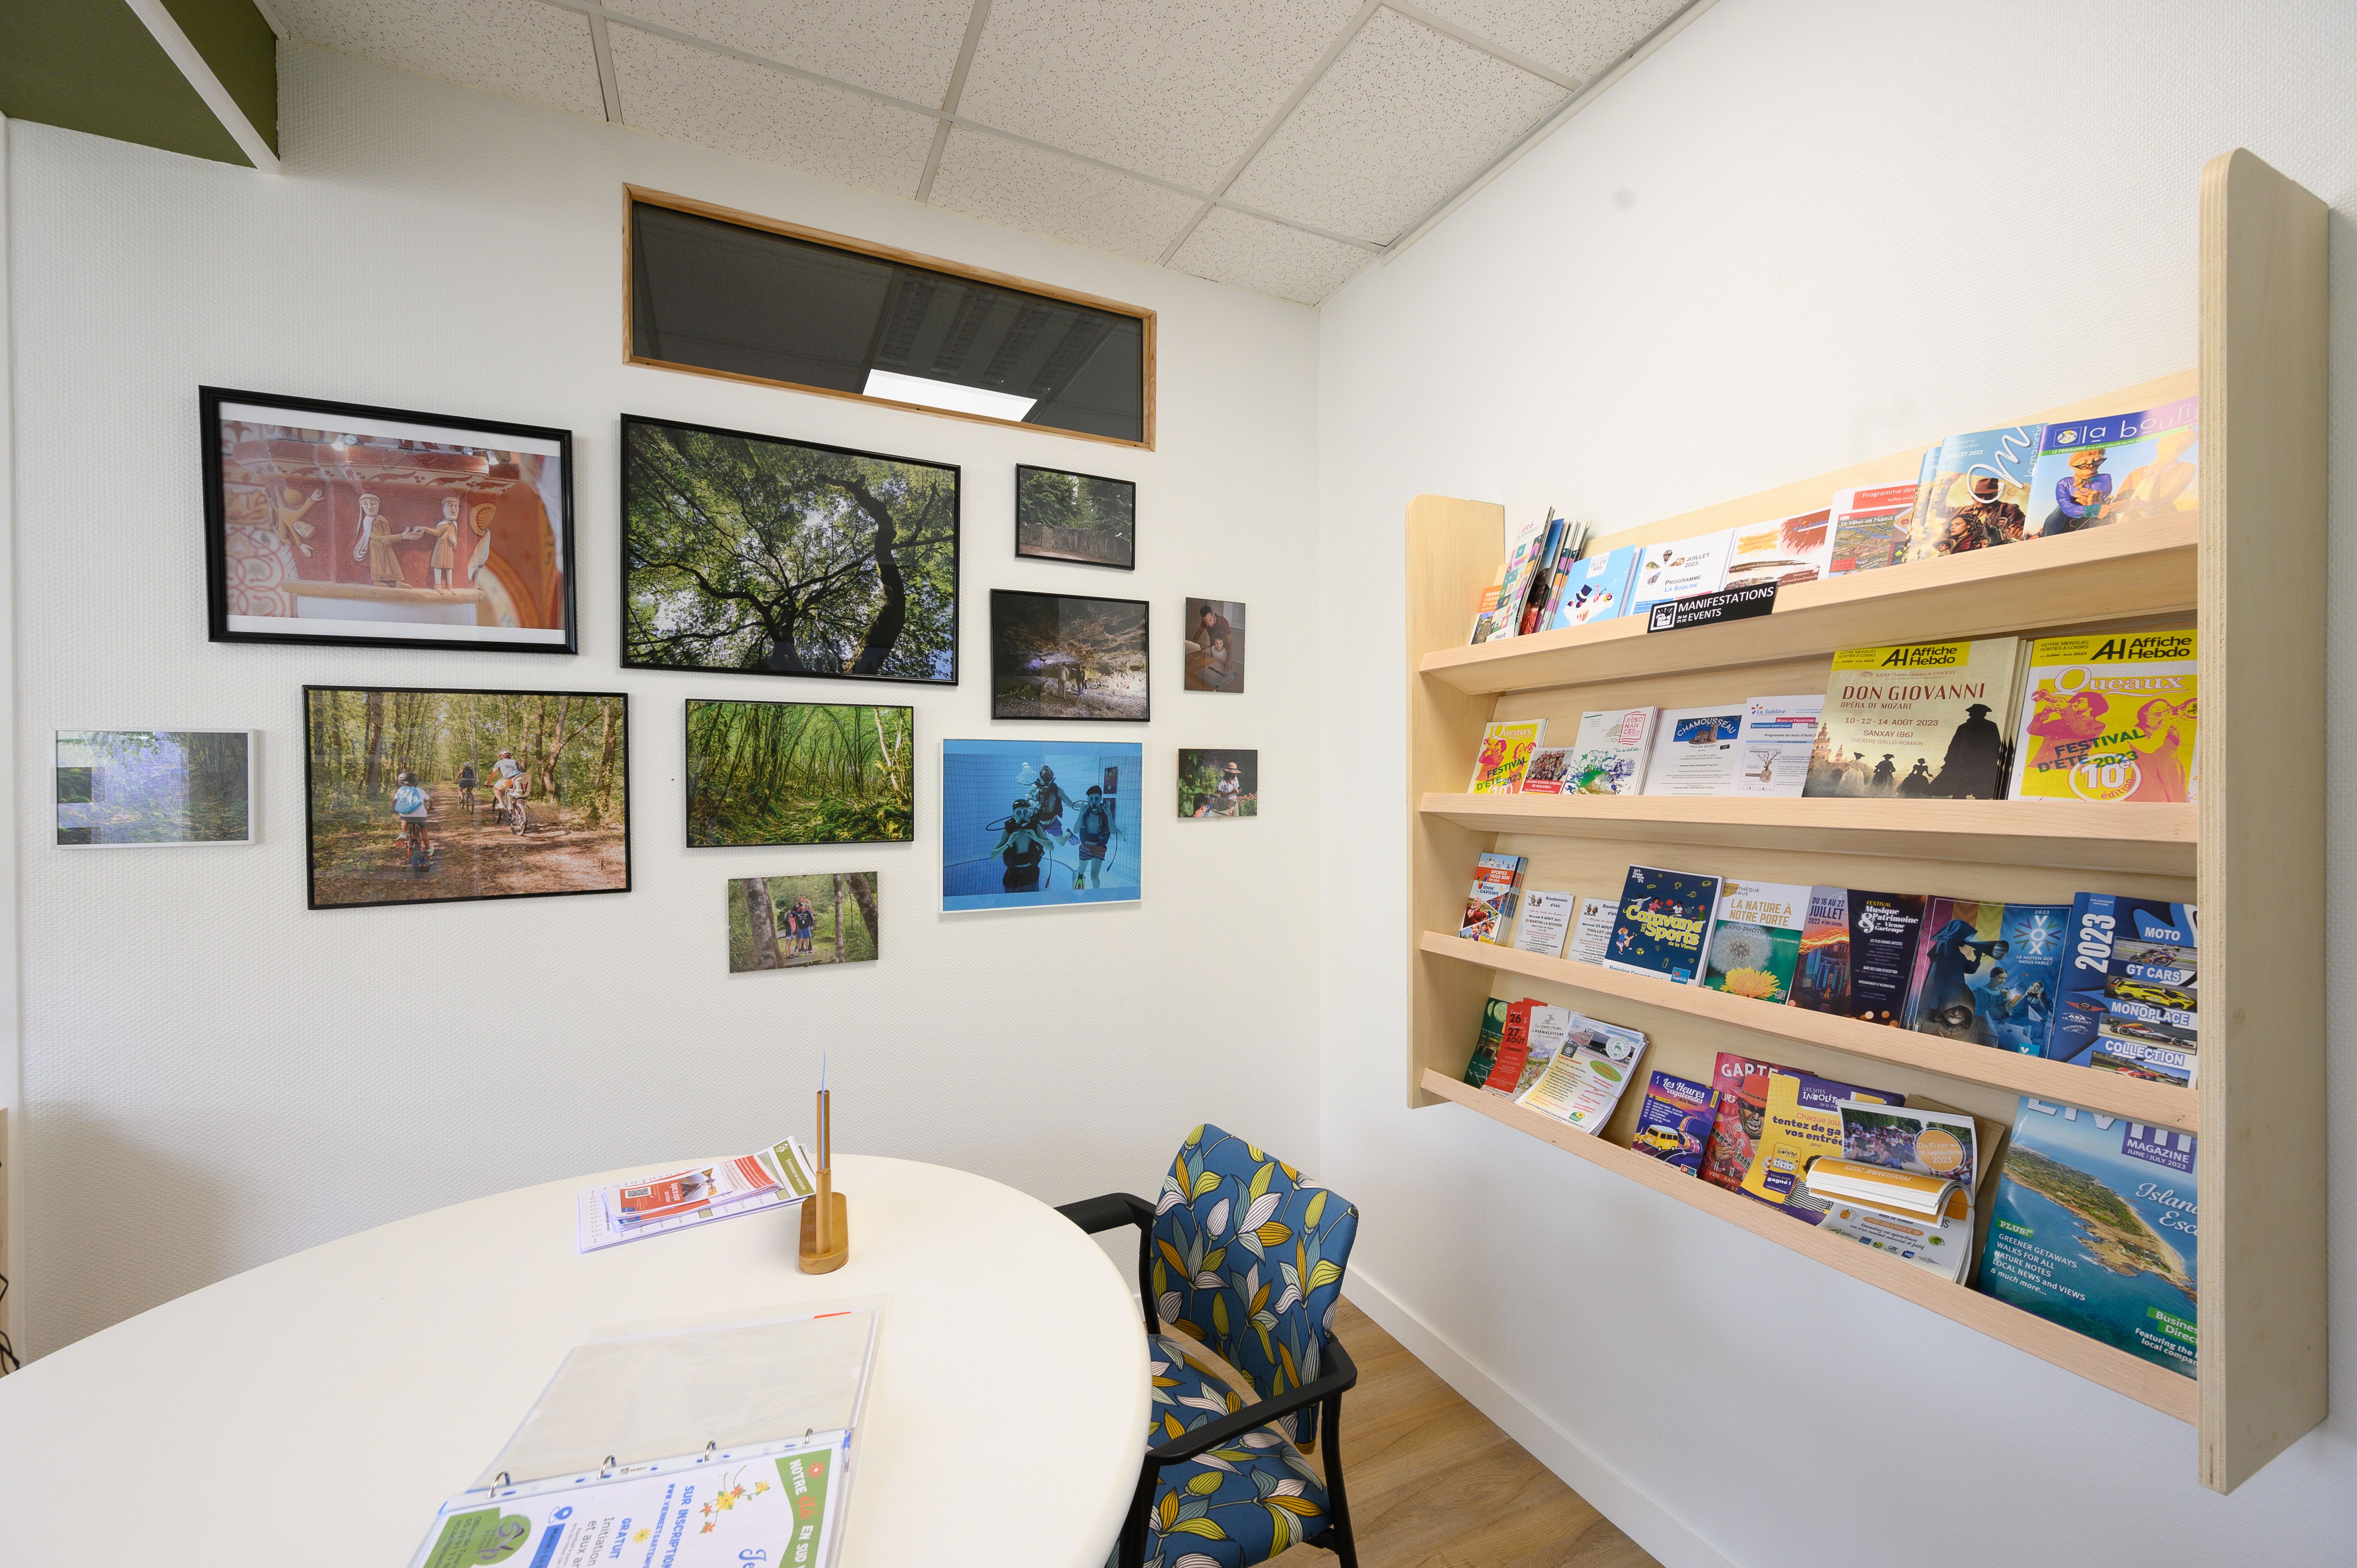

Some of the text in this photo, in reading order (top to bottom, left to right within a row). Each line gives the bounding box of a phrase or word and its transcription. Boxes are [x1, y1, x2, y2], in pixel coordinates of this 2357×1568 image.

[2082, 426, 2106, 443] la
[1862, 490, 1902, 499] Programme
[1686, 553, 1710, 562] JUILLET
[1678, 586, 1774, 613] MANIFESTATIONS
[1688, 609, 1722, 622] EVENTS
[1909, 655, 1956, 666] Hebdo
[2128, 646, 2191, 659] Hebdo
[2051, 666, 2185, 697] Queaux
[1842, 683, 1985, 701] DON GIOVANNI
[1491, 723, 1532, 740] Queaux
[1677, 718, 1736, 736] CHAMOUSSEAU
[2054, 729, 2146, 756] FESTIVAL
[1487, 756, 1528, 779] FESTIVAL
[2037, 750, 2138, 773] D'ÉTÉ 2023
[2101, 779, 2134, 799] édition
[1731, 899, 1792, 915] LA NATURE À
[1809, 905, 1844, 920] JUILLET
[1865, 906, 1899, 915] Musique
[1626, 905, 1703, 933] Caravane
[1729, 909, 1790, 926] NOTRE PORTE
[1858, 912, 1919, 933] & Patrimoine
[1645, 921, 1700, 946] Sports
[1875, 925, 1904, 934] Gartempe
[2144, 927, 2180, 942] MOTO
[1680, 943, 1697, 951] Vienne
[2075, 913, 2116, 973] 2023
[2126, 964, 2181, 982] GT CARS
[1509, 1014, 1522, 1024] 26
[2111, 1001, 2189, 1026] MONOPLACE
[1506, 1036, 1525, 1045] AOÛT
[1507, 1028, 1520, 1037] 27
[2105, 1040, 2185, 1067] COLLECTION
[1663, 1078, 1705, 1099] Les Heures
[1667, 1088, 1703, 1104] vagabondes
[1773, 1116, 1825, 1132] tentez de
[2127, 1139, 2190, 1164] MAGAZINE
[2127, 1149, 2186, 1170] JUNE JULY 2023
[1767, 1177, 1788, 1185] gagné
[2000, 1220, 2029, 1236] PLUS:
[1997, 1241, 2055, 1270] WALKS FOR ALL
[1999, 1233, 2078, 1268] GREENER GETAWAYS
[1995, 1250, 2051, 1277] NATURE NOTES
[1993, 1258, 2086, 1301] LOCAL NEWS and VIEWS
[1998, 1271, 2019, 1283] much
[2020, 1281, 2047, 1295] more...
[2135, 1328, 2193, 1356] Featuring the
[790, 1459, 818, 1563] NOTRE été EN SUD
[578, 1520, 597, 1554] et aux
[608, 1518, 632, 1560] GRATUIT
